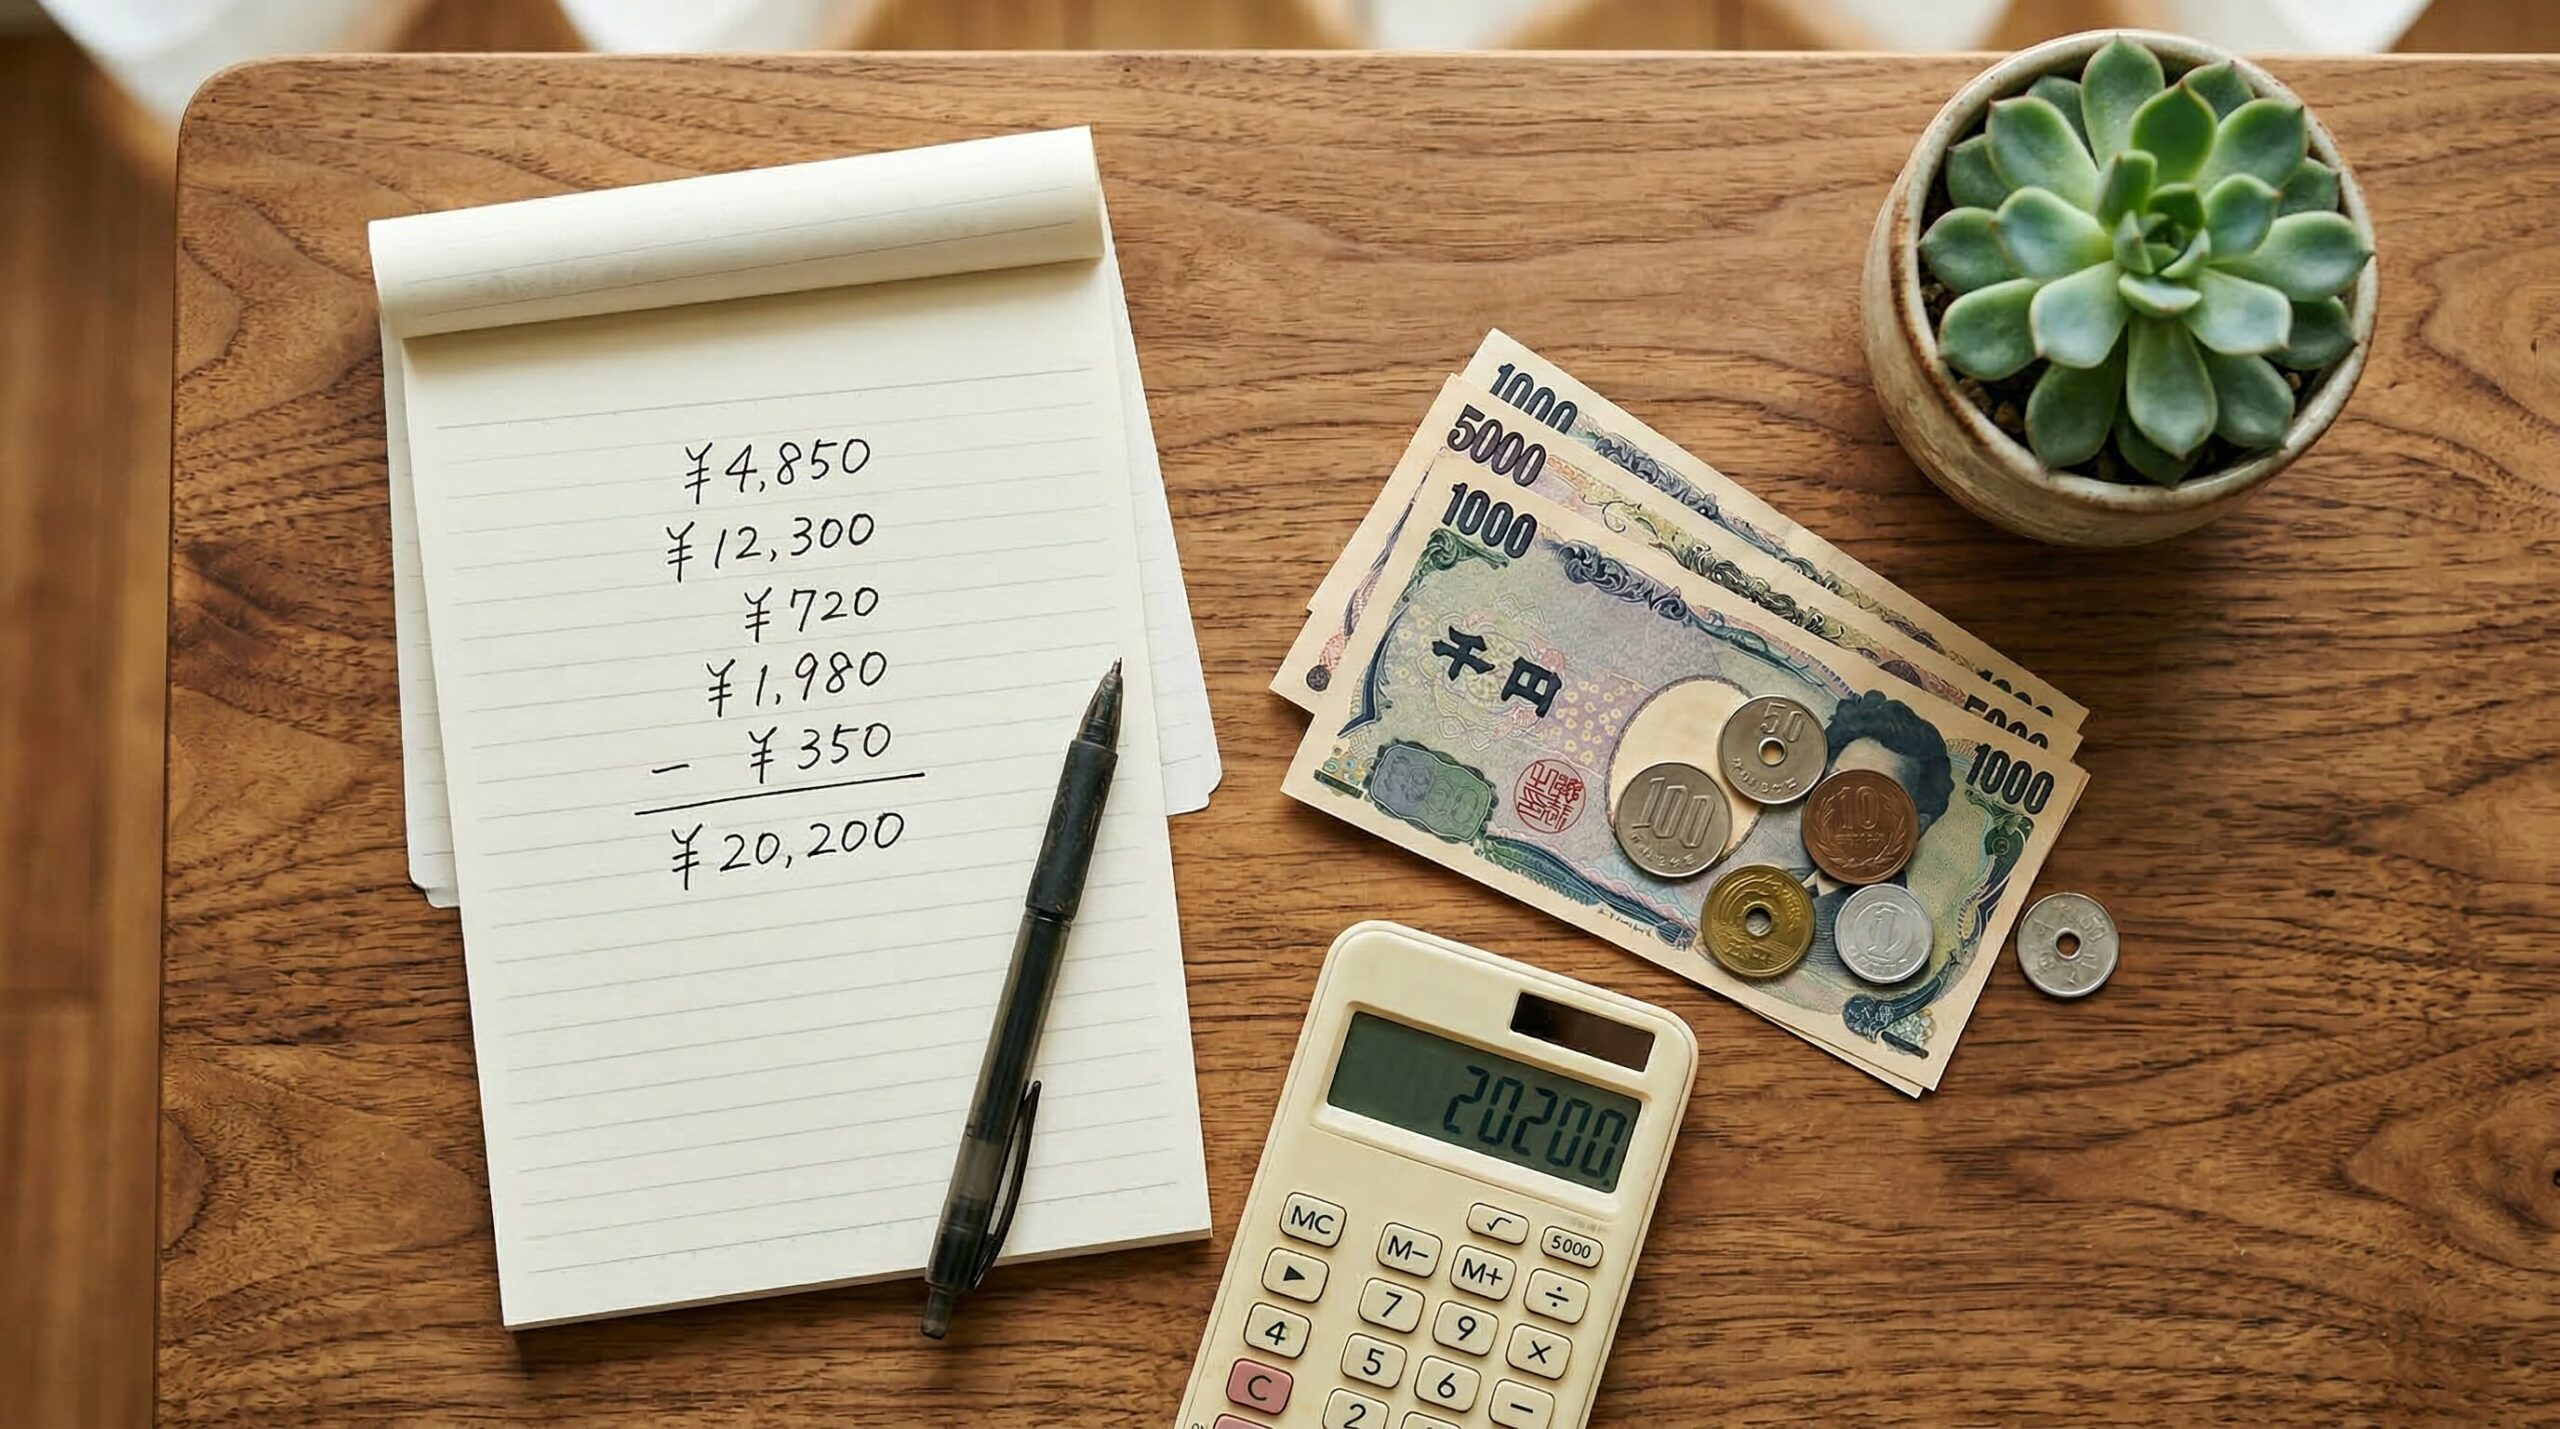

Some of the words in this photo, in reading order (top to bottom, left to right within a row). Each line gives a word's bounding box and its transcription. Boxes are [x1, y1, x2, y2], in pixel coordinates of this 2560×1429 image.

[1447, 404, 1546, 487] 5000
[685, 439, 870, 504] ¥4,850
[1441, 483, 1538, 559] 1000
[667, 514, 874, 582] ¥12,300
[745, 587, 879, 643] ¥720
[707, 652, 887, 717] ¥1,980
[1432, 626, 1562, 718] 千円
[1760, 701, 1805, 742] 50
[748, 723, 891, 784] ¥350
[1966, 743, 2055, 815] 1000
[1632, 777, 1716, 848] 100
[1841, 786, 1880, 830] 10
[672, 812, 904, 890] ¥20,200
[1291, 1205, 1334, 1236] MC
[1551, 1235, 1591, 1259] 5000
[1461, 1257, 1503, 1286] M+
[1382, 1291, 1403, 1317] 7
[1265, 1321, 1287, 1346] 4
[1458, 1315, 1477, 1341] 9
[1362, 1348, 1385, 1376] 5
[1247, 1375, 1273, 1401] C
[1437, 1372, 1456, 1399] 6
[1343, 1403, 1367, 1429] 2
